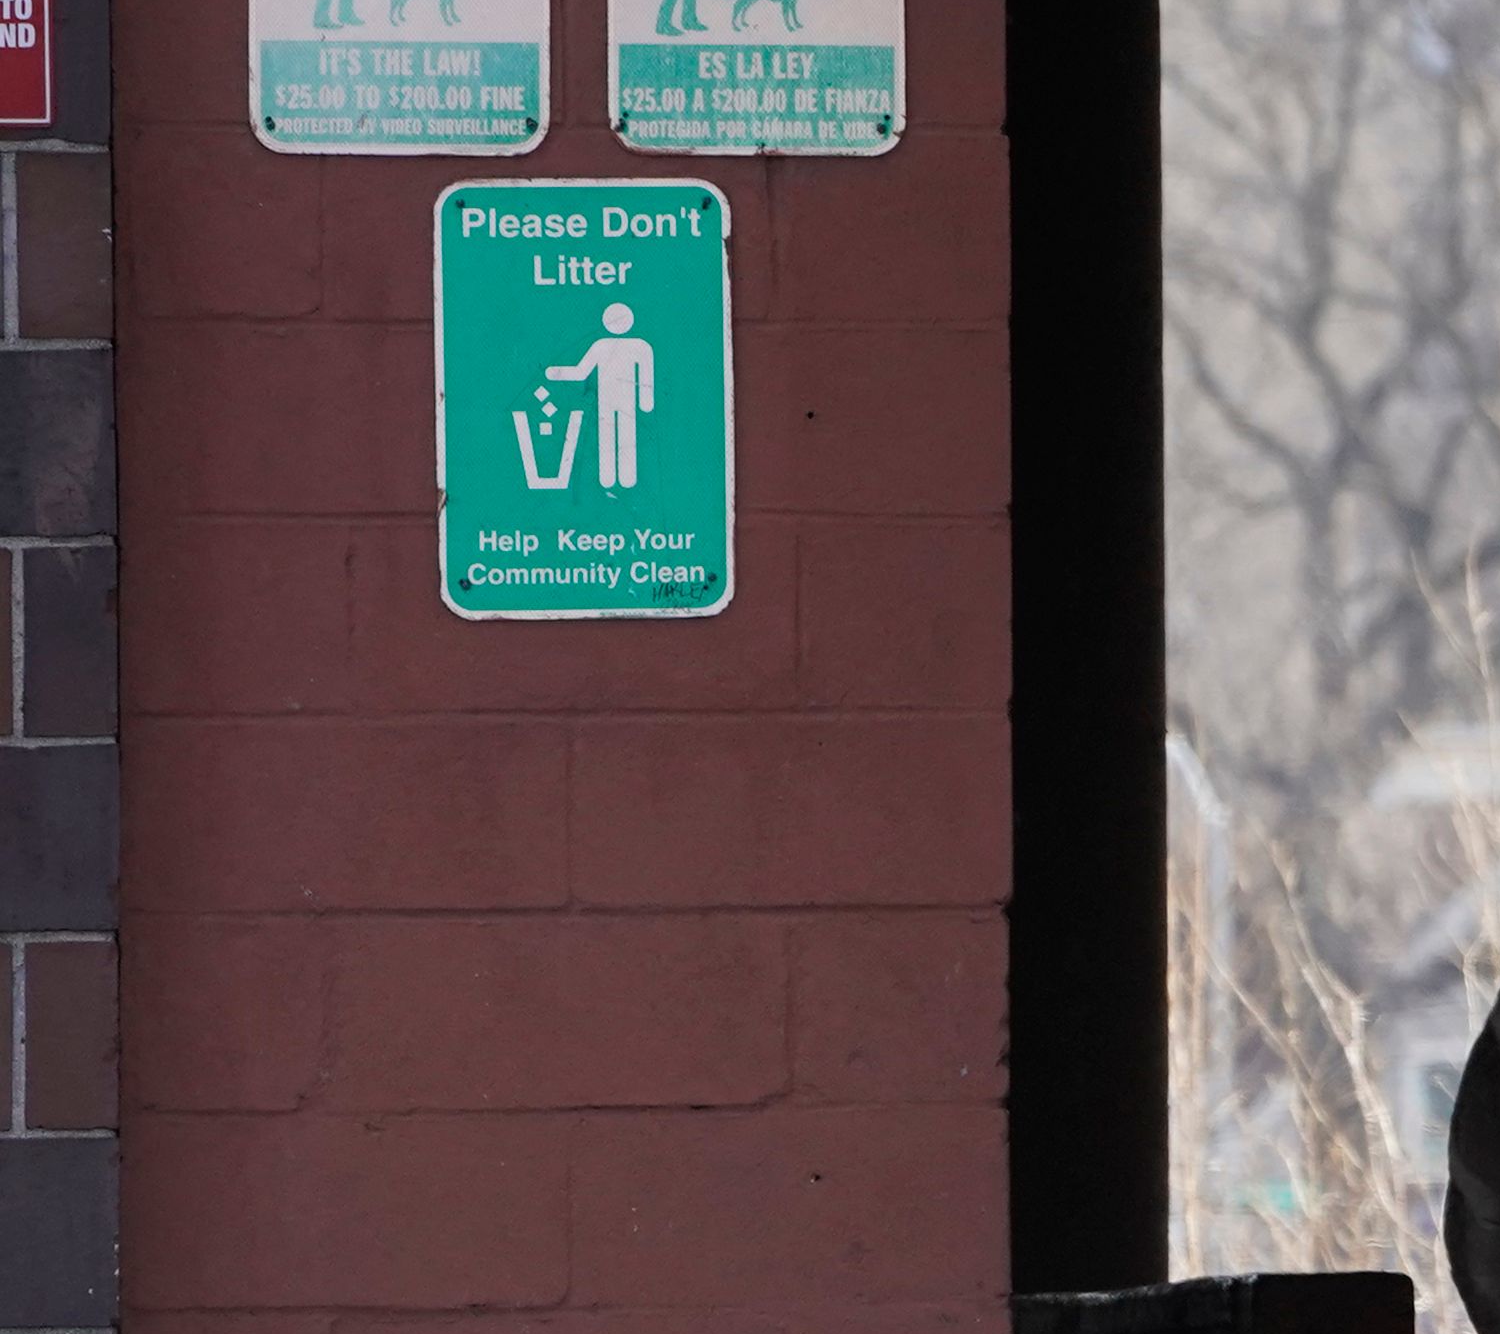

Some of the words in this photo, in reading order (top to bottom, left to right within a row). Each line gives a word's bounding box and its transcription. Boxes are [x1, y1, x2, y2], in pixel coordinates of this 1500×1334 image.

[319, 48, 362, 76] IT'S
[372, 48, 414, 76] THE
[424, 49, 482, 77] LAW!
[700, 52, 727, 79] ES
[736, 52, 766, 79] LA
[772, 52, 816, 79] LEY
[275, 84, 345, 110] $25.00
[354, 85, 380, 110] TO
[388, 85, 472, 111] $200.00
[480, 86, 526, 111] FINE
[622, 87, 687, 113] $25.00
[692, 88, 705, 113] A
[711, 87, 787, 113] $200.00
[794, 88, 818, 113] DE
[825, 88, 891, 113] FIANZA
[427, 118, 527, 136] SURVEILLANCE
[716, 121, 747, 139] POR
[818, 121, 837, 139] DE
[461, 207, 588, 237] Please
[602, 207, 702, 237] Don't
[533, 255, 633, 286] Litter
[478, 529, 540, 557] Help
[558, 529, 627, 558] Keep
[635, 529, 696, 550] Your
[467, 563, 622, 589] Community
[630, 561, 705, 583] Clean
